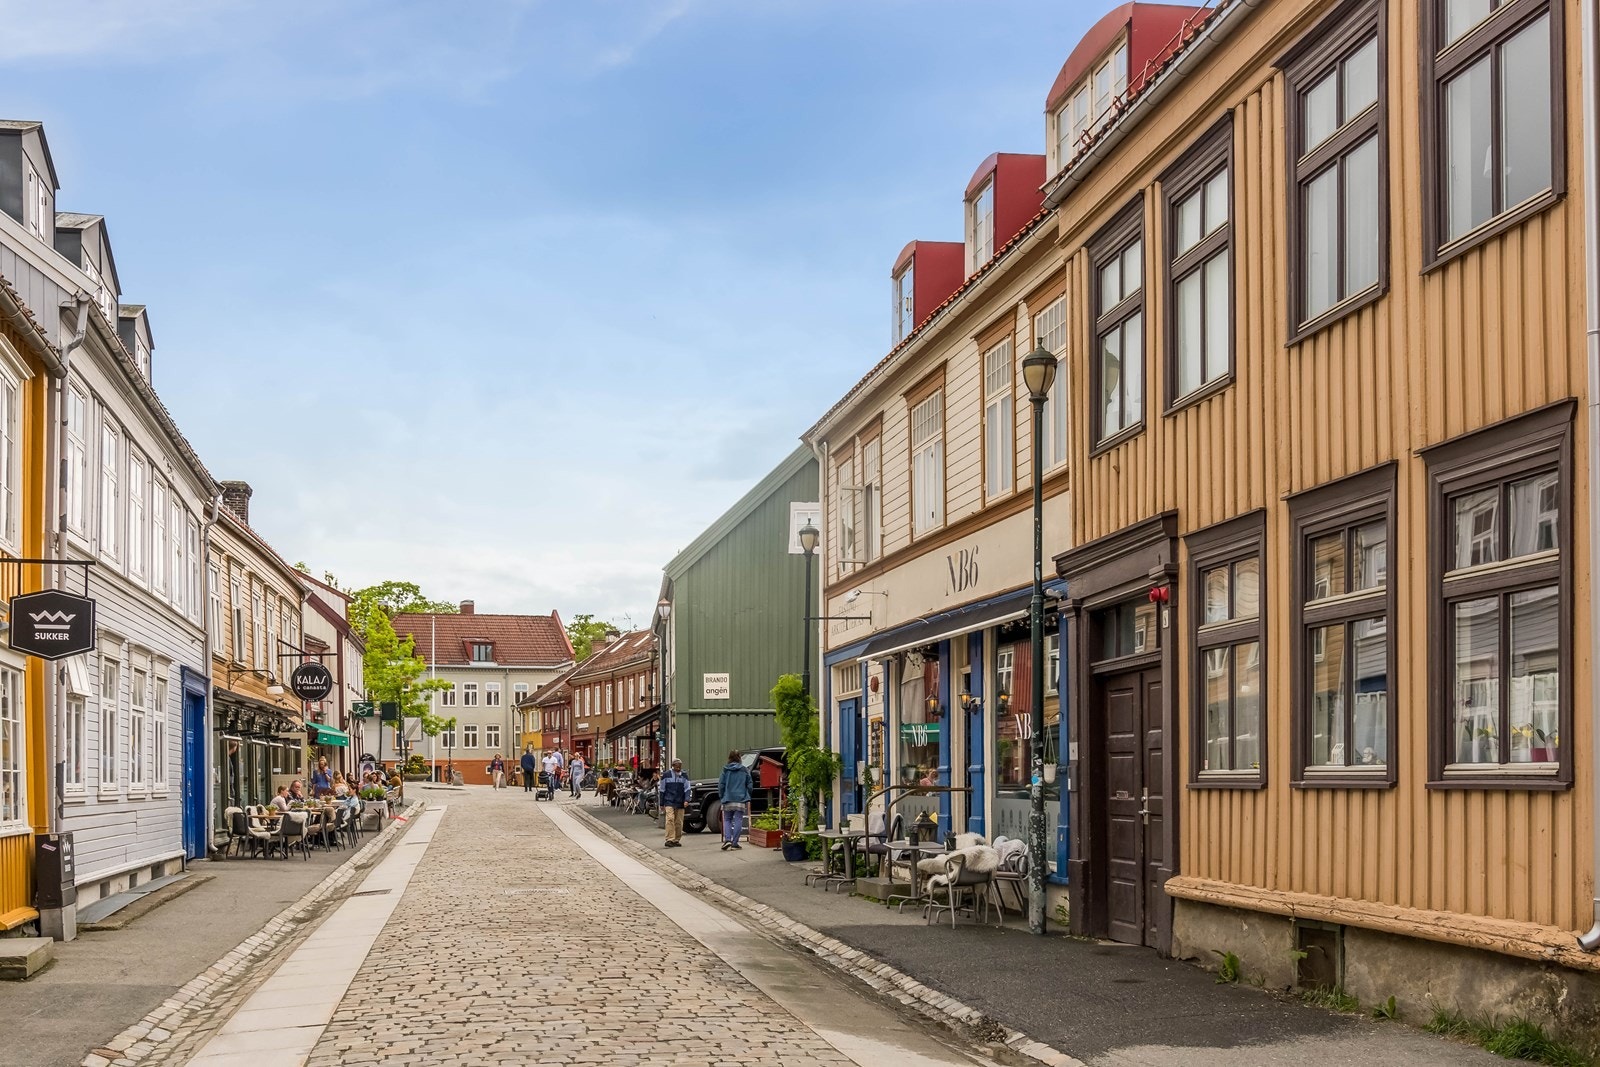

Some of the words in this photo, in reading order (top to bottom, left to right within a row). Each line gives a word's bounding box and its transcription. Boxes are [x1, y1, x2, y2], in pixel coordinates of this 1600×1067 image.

[945, 544, 979, 597] NB6
[34, 632, 70, 640] SUKKER
[296, 676, 326, 684] KALAS
[911, 724, 928, 748] NB6
[1014, 712, 1031, 740] NB
